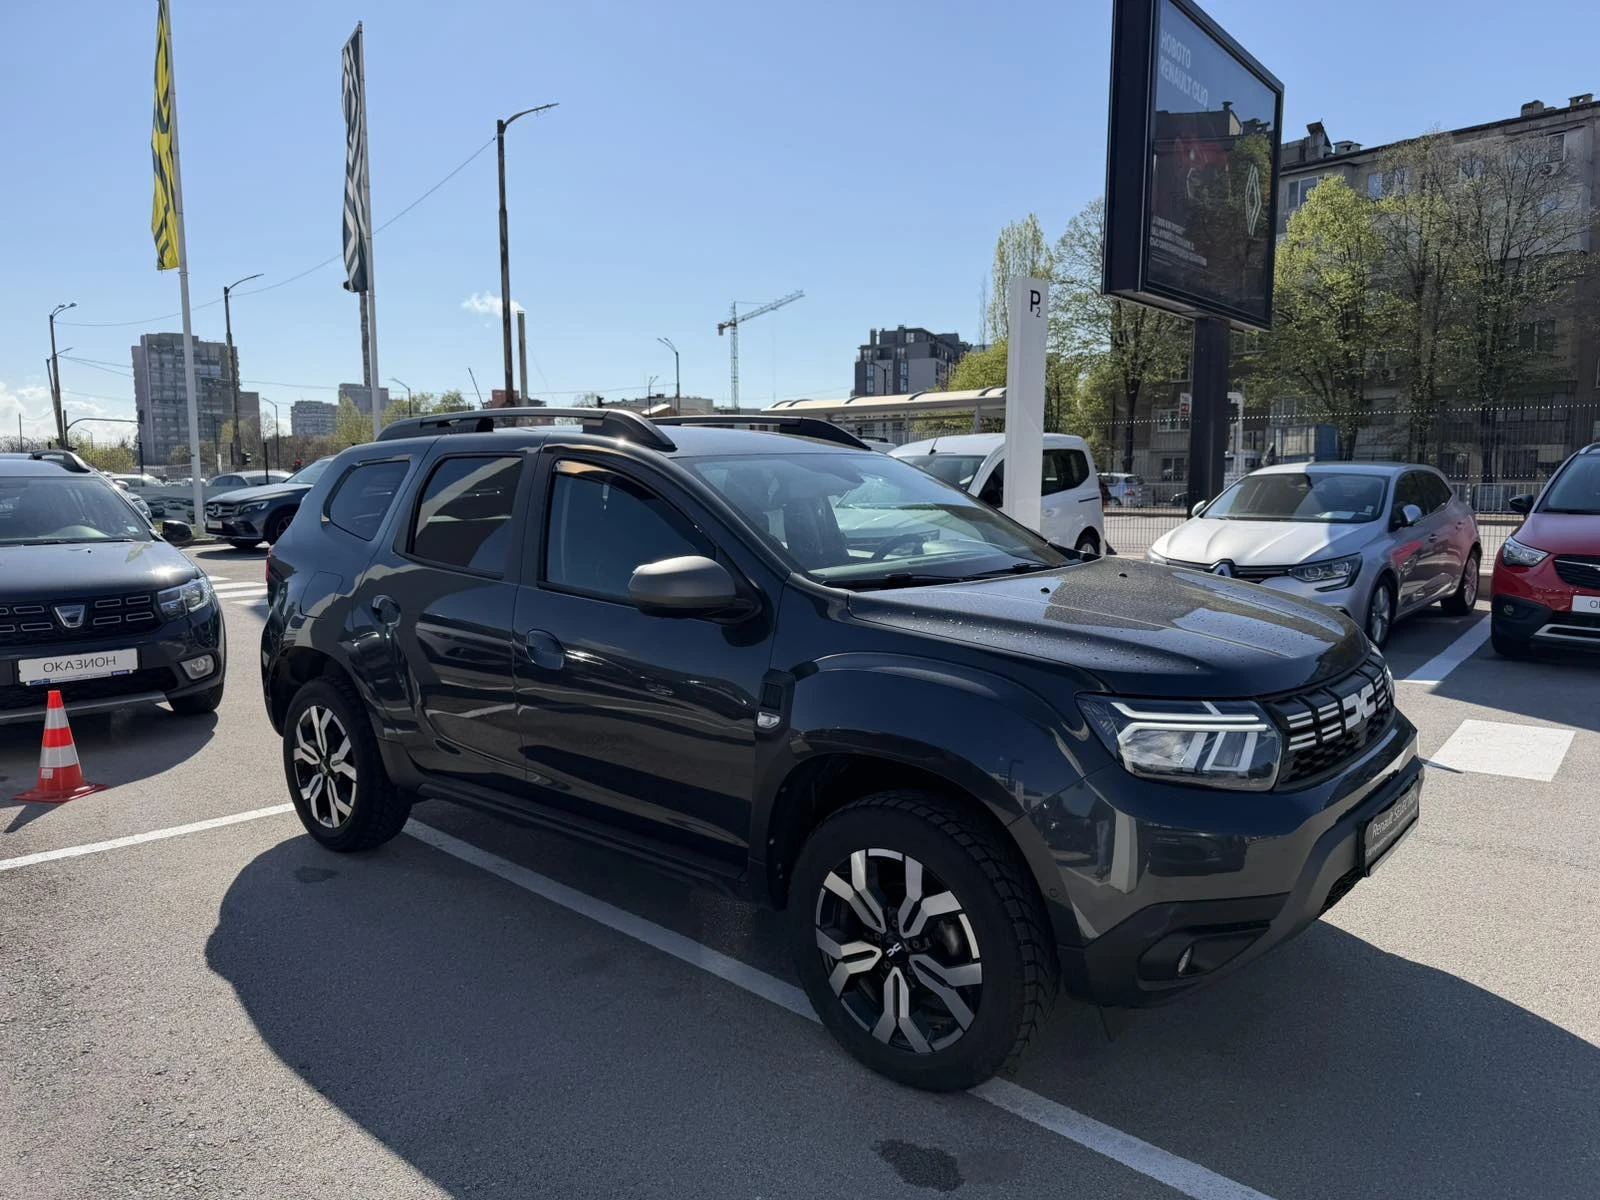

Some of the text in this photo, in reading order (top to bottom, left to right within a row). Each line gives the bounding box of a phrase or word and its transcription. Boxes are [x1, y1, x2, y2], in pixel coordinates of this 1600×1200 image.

[1160, 55, 1208, 108] RENAULT CLIO
[43, 655, 117, 673] ОКАЗИОН
[1372, 811, 1394, 839] Renault
